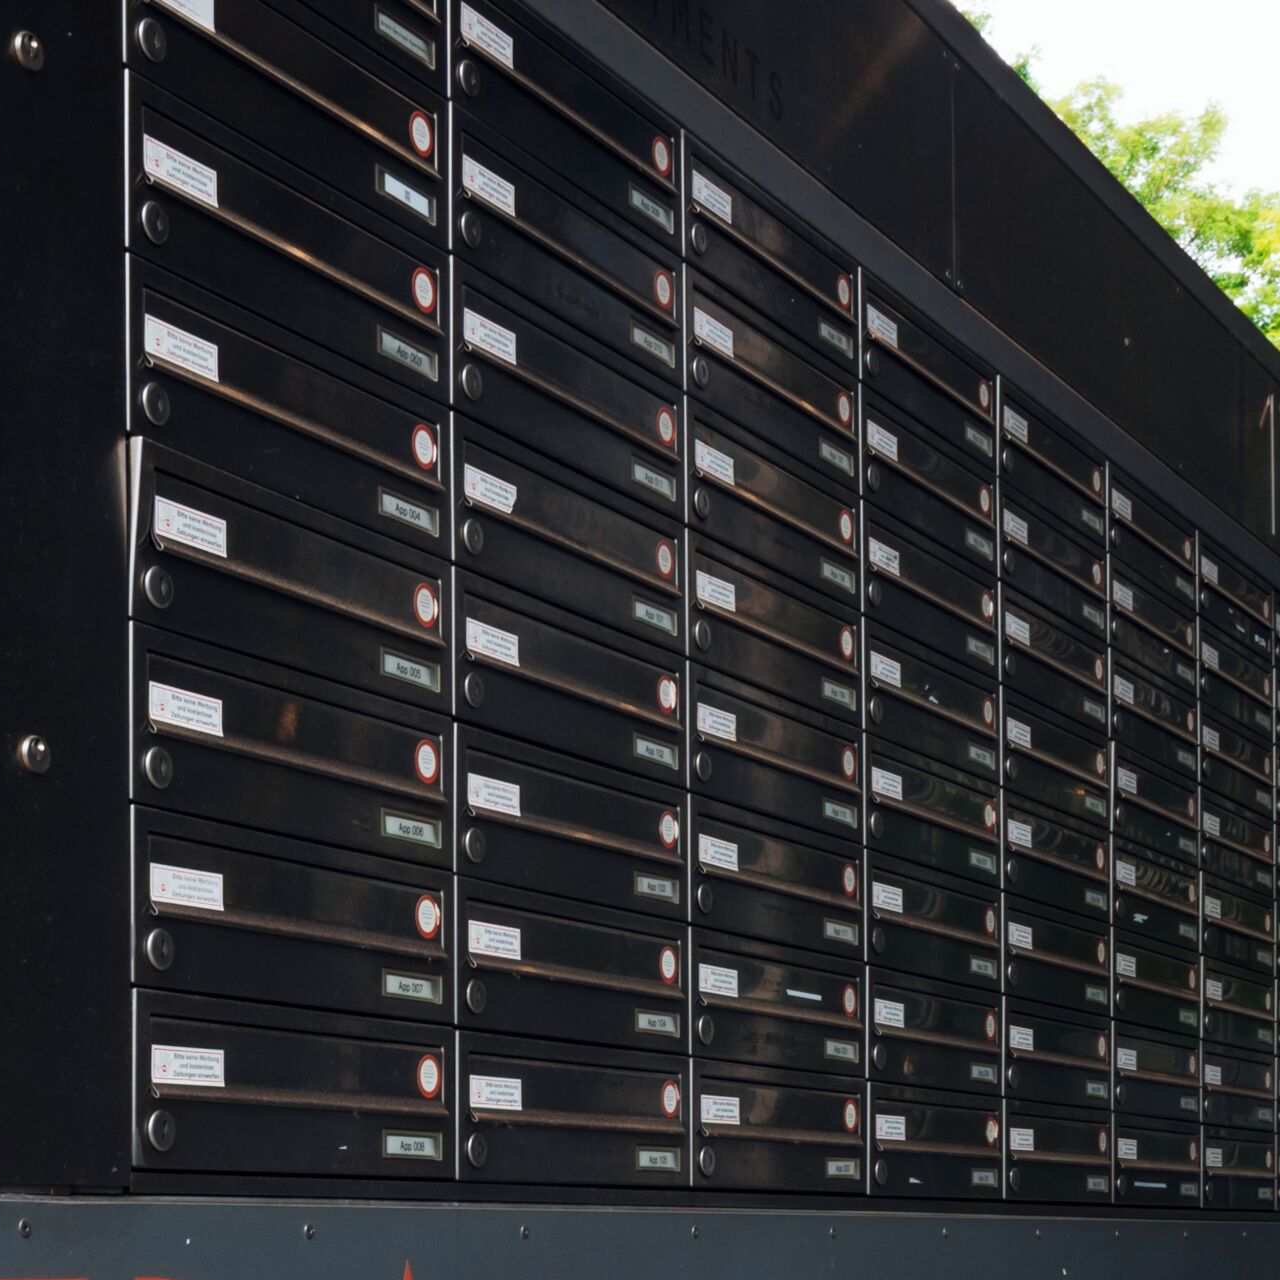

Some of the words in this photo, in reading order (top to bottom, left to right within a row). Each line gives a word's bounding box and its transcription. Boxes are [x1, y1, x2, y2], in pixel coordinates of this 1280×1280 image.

[397, 346, 409, 361] App
[410, 352, 423, 367] 003
[396, 504, 408, 516] App
[408, 508, 421, 522] 004
[396, 662, 409, 676] App
[410, 667, 422, 680] 005
[398, 823, 411, 836] App
[412, 826, 424, 838] 006
[398, 982, 411, 994] App
[412, 983, 424, 994] 007
[400, 1141, 413, 1152] App
[414, 1142, 425, 1152] 008
